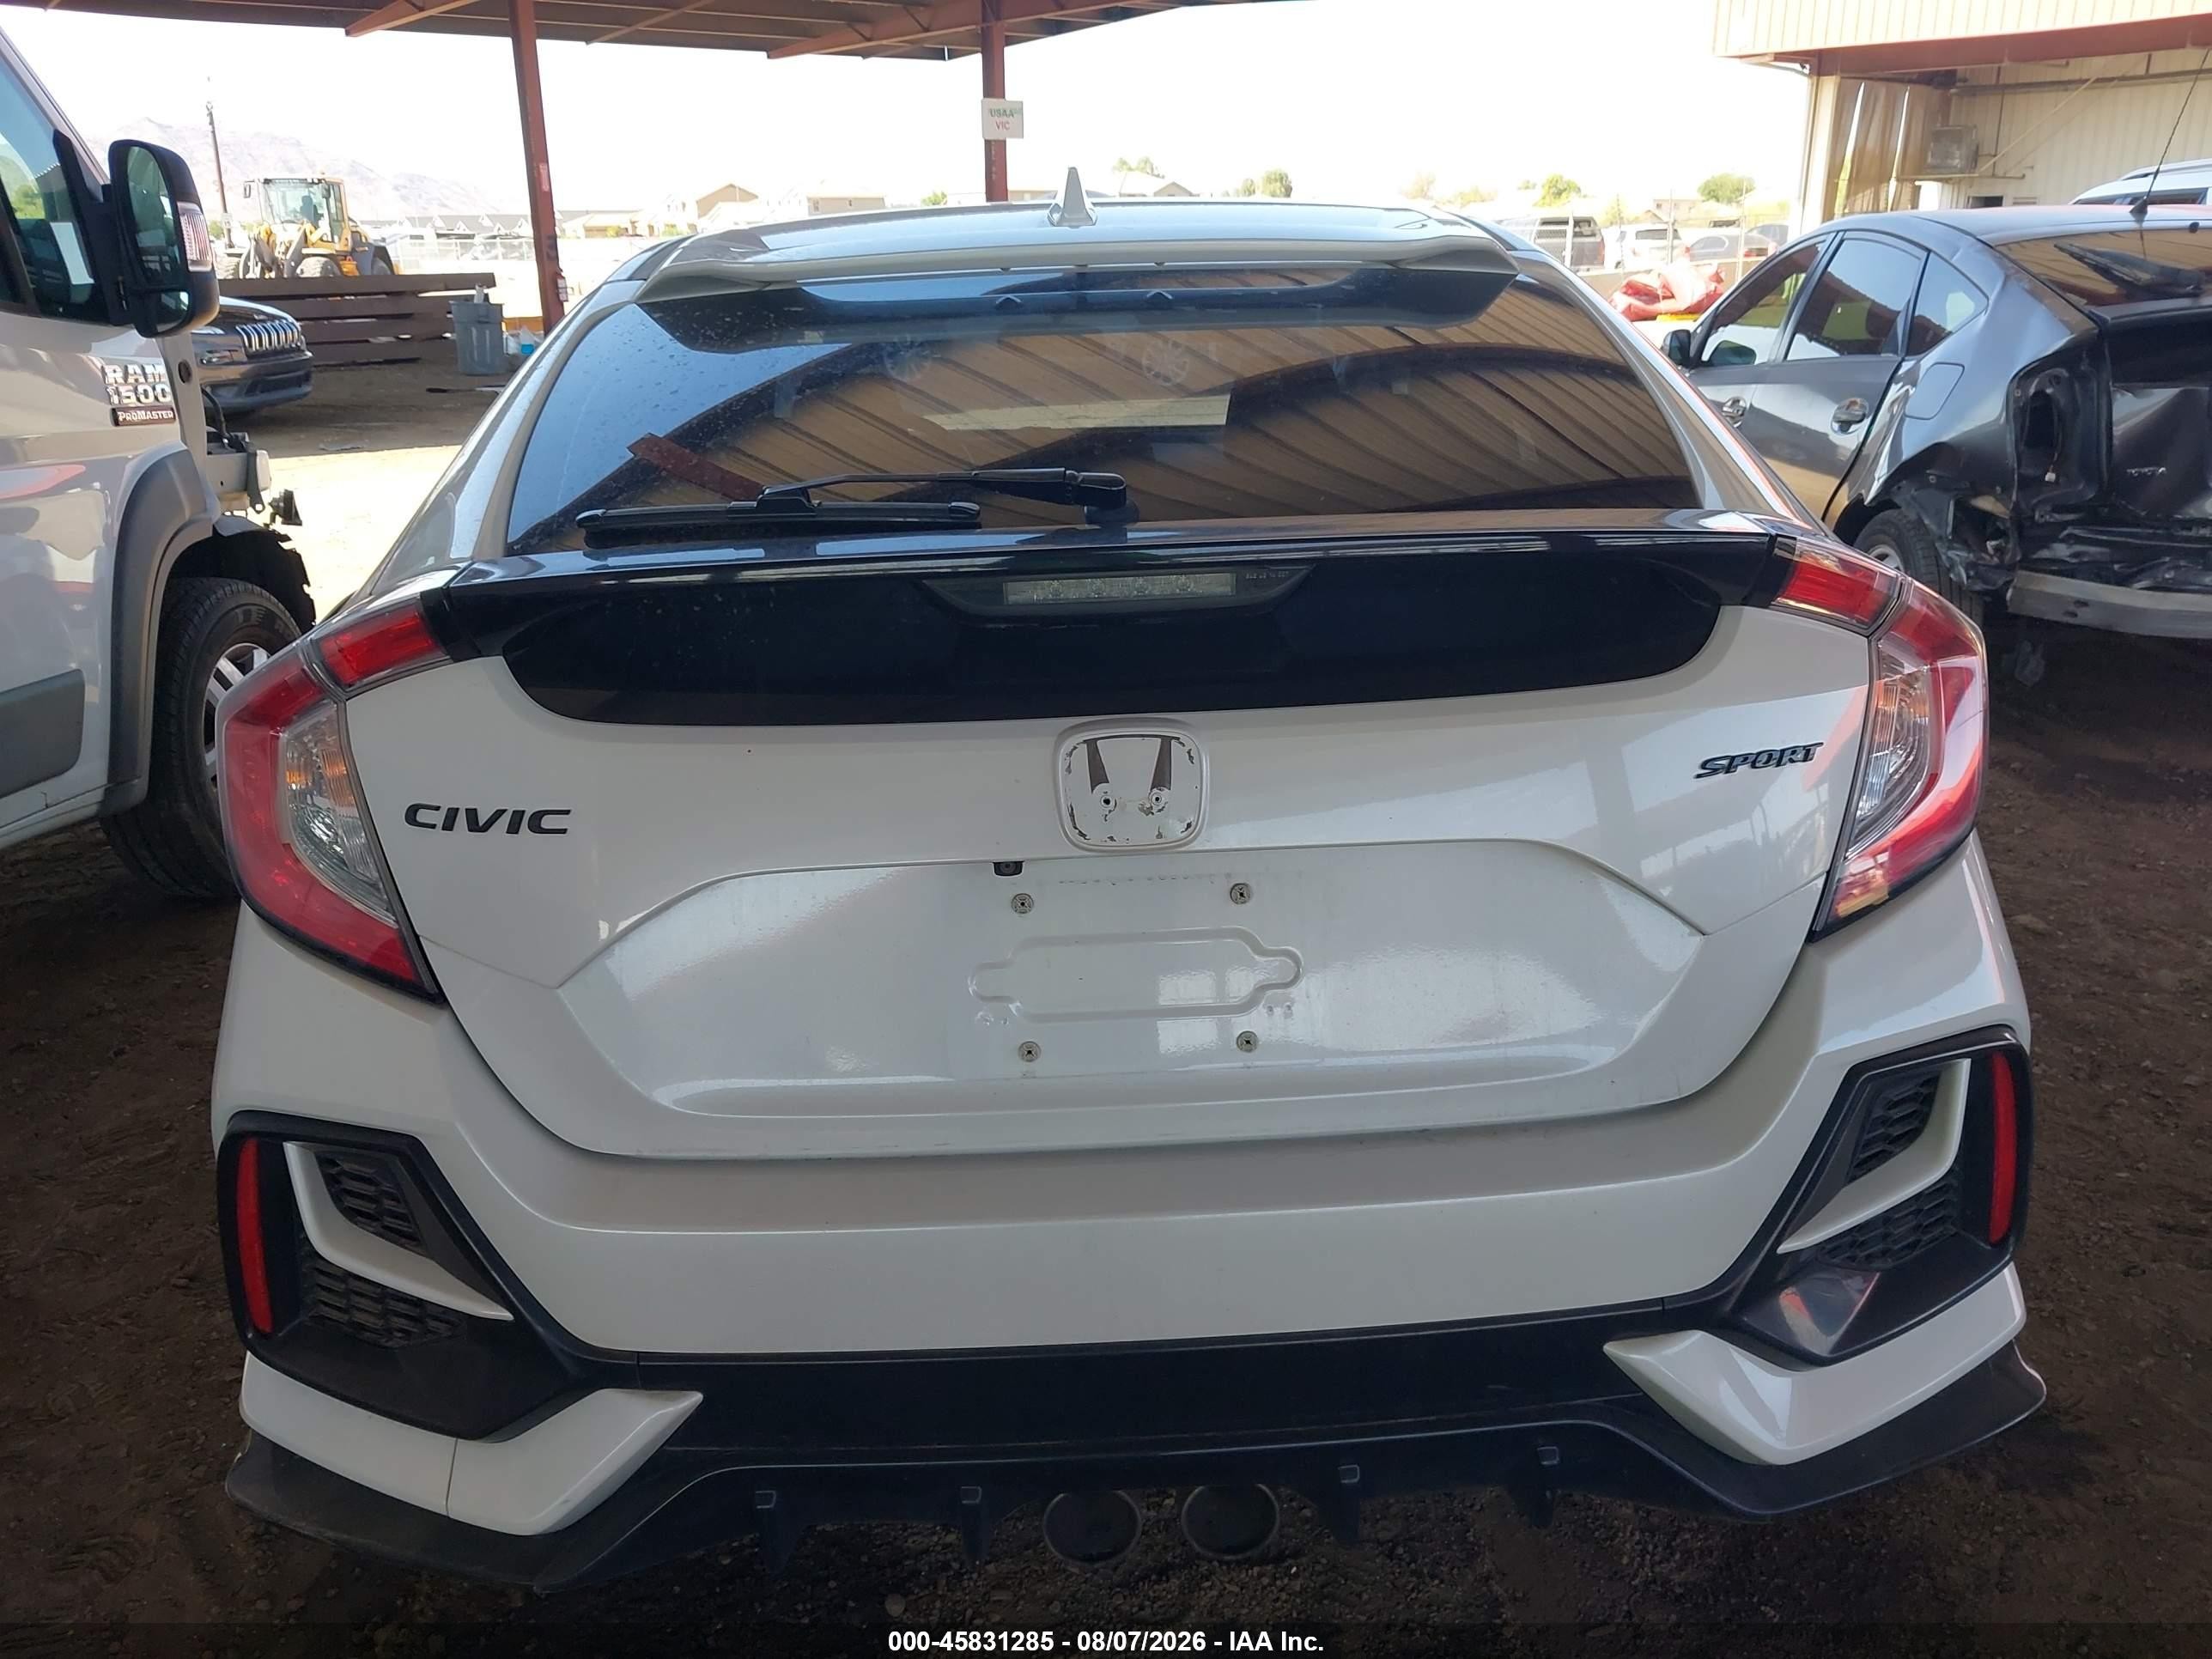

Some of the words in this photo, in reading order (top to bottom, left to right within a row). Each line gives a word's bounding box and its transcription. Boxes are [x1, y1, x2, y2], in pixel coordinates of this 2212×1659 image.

[989, 108, 1014, 118] USAA
[995, 120, 1010, 130] VIC
[101, 363, 167, 384] RAM
[106, 383, 172, 404] 1500
[1693, 742, 1824, 779] SPORT
[404, 803, 571, 835] CIVIC
